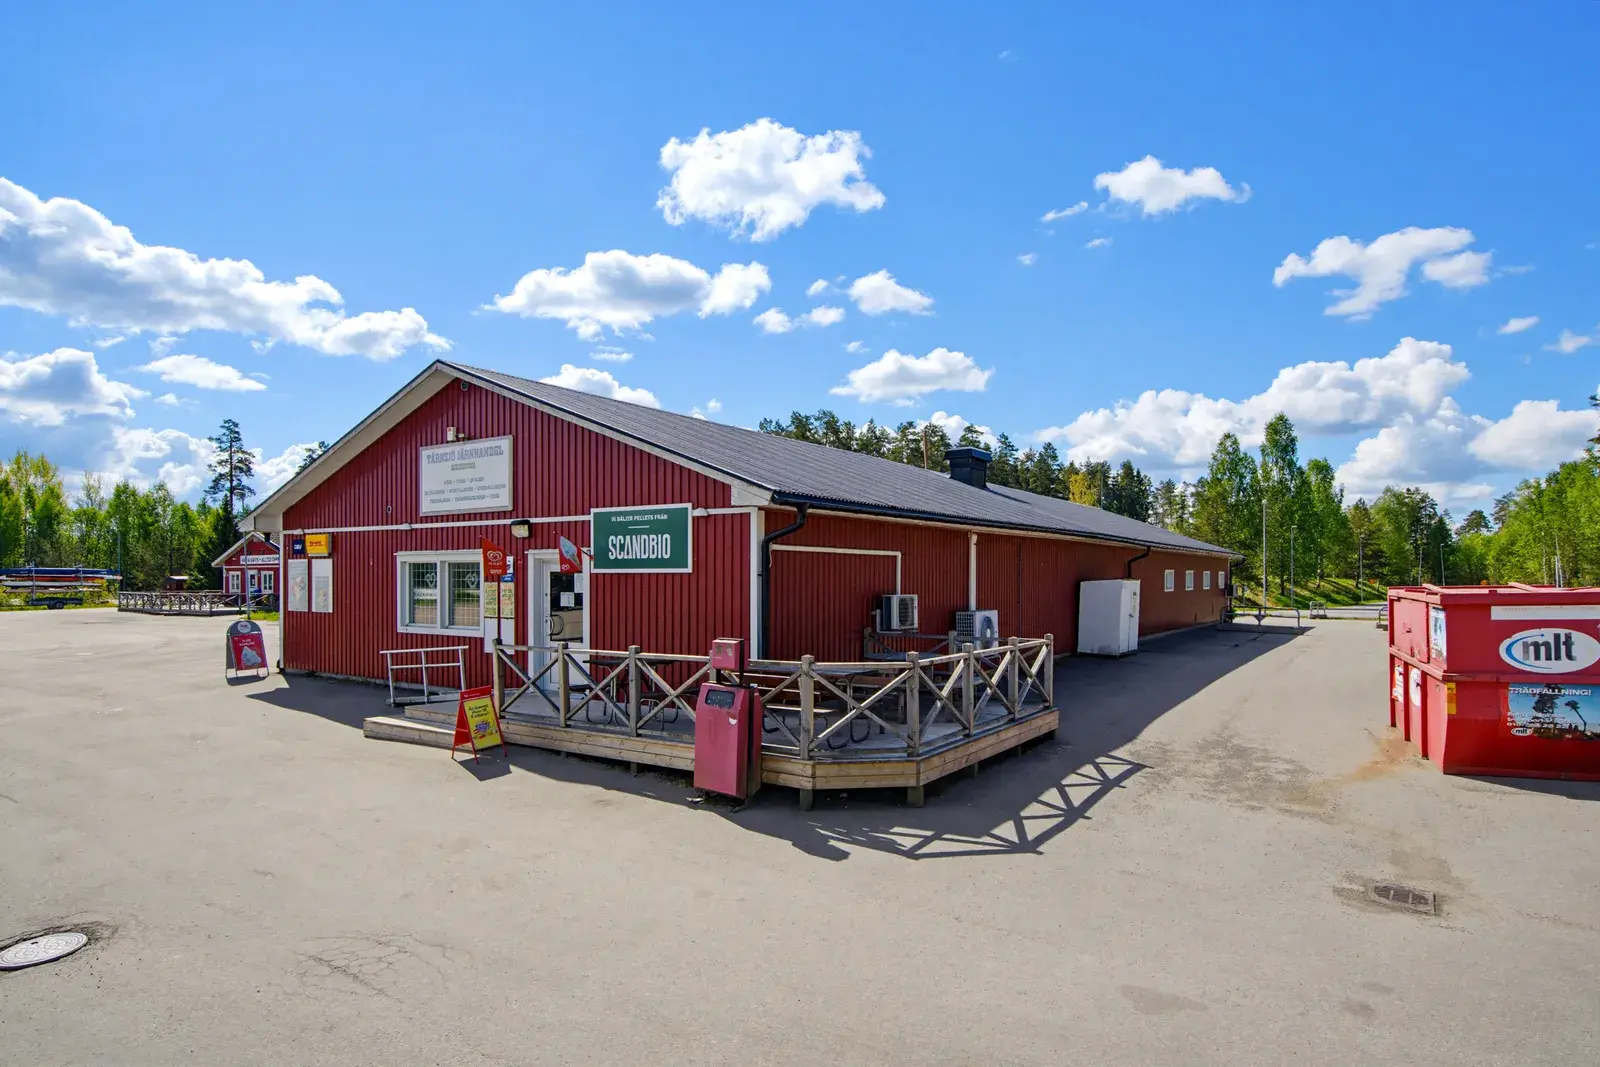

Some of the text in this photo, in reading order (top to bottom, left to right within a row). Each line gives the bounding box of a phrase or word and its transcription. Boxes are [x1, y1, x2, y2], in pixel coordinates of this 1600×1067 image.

[457, 445, 504, 461] JÄRNHANDEL
[617, 514, 634, 522] SÄLJER
[608, 533, 671, 560] SCANDBIO
[1522, 632, 1577, 661] mlt
[1508, 686, 1592, 696] TRÄDFÄLLNING!
